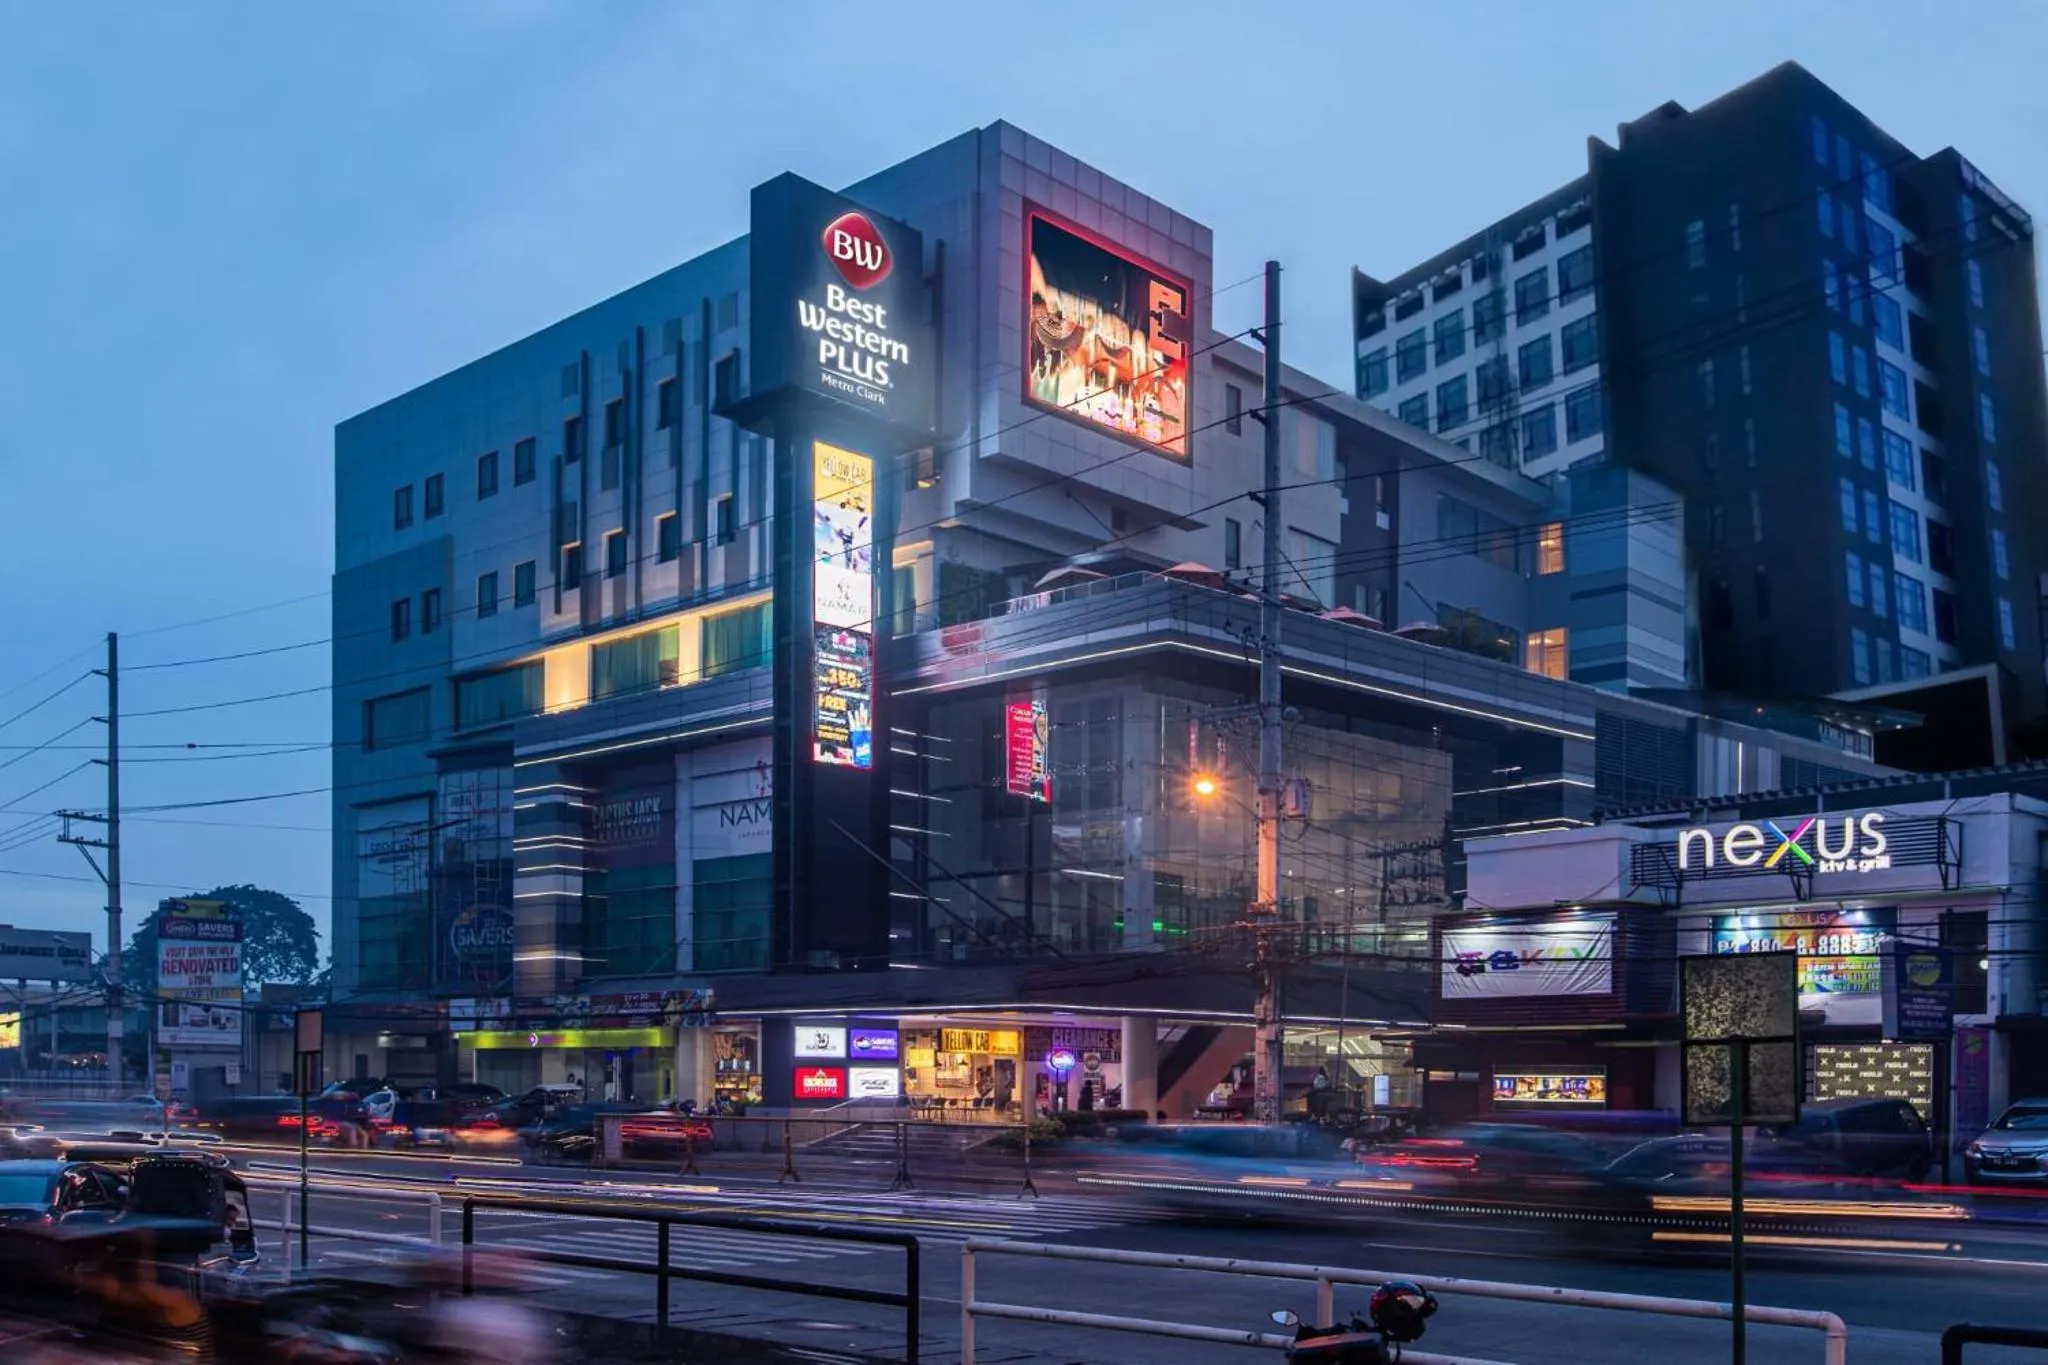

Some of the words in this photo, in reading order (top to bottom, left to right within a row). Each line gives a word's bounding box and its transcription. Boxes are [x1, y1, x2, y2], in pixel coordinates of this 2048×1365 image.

[832, 229, 882, 271] BW
[826, 283, 887, 328] Best
[798, 299, 909, 364] Western
[819, 338, 890, 386] PLUS
[821, 372, 854, 394] Metro
[856, 382, 886, 406] Clark
[162, 957, 239, 976] RENOVATED
[944, 1030, 973, 1051] YELLOW
[975, 1031, 990, 1051] CAB
